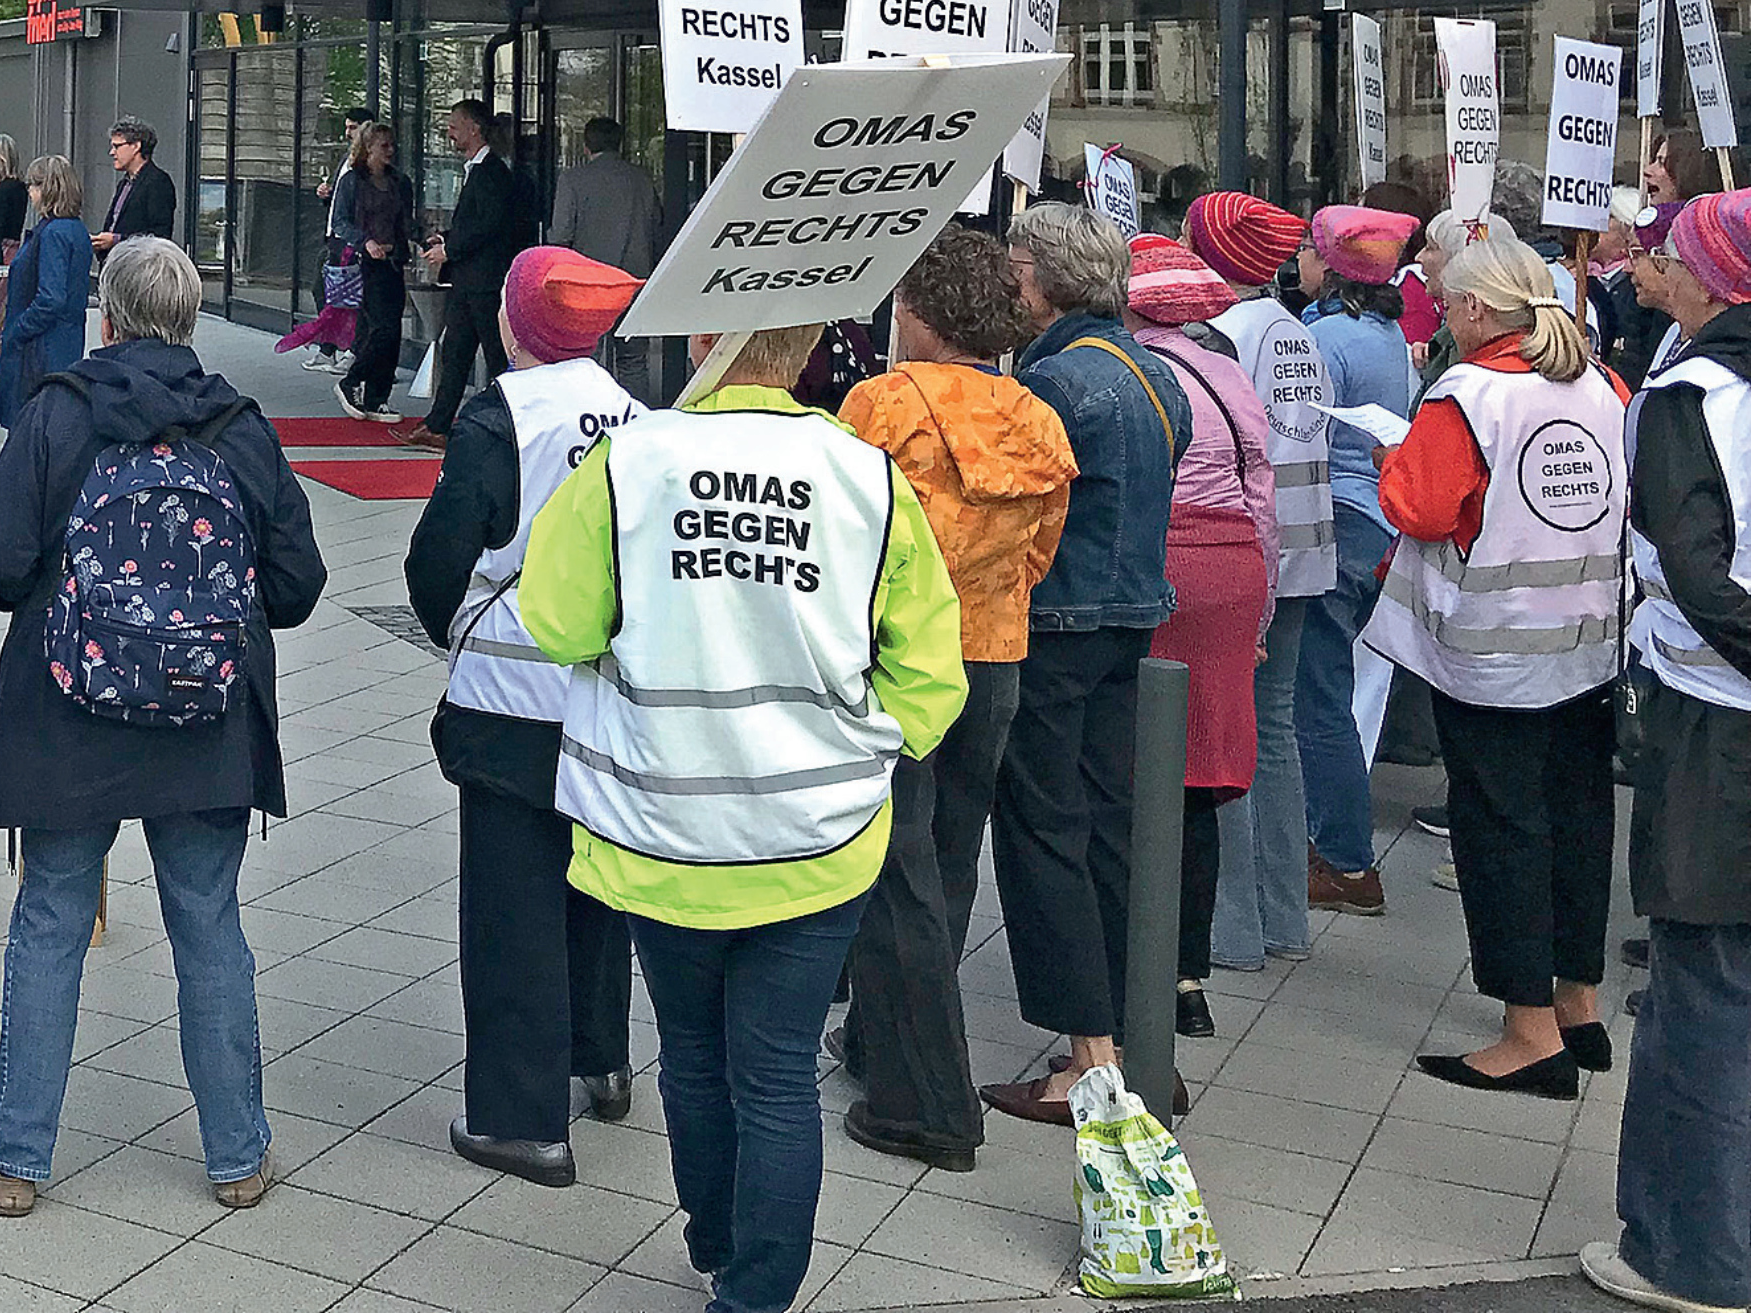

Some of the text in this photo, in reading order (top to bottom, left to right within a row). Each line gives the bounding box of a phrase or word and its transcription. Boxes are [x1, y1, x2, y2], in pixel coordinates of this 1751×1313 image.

[681, 8, 790, 43] RECHTS
[697, 56, 781, 89] Kassel
[1565, 54, 1614, 86] OMAS
[1460, 74, 1492, 99] OMAS
[814, 111, 976, 148] OMAS
[1458, 107, 1497, 131] GEGEN
[1559, 115, 1613, 147] GEGEN
[762, 160, 956, 199] GEGEN
[1105, 174, 1130, 200] OMAS
[1548, 175, 1612, 209] RECHTS
[1106, 194, 1134, 222] GEGEN
[711, 208, 928, 248] RECHTS
[701, 256, 874, 293] Kassel
[1273, 362, 1317, 380] GEGEN
[1272, 385, 1322, 404] RECHTS
[1543, 441, 1585, 456] OMAS
[1541, 461, 1593, 477] GEGEN
[690, 470, 812, 510] OMAS
[1541, 482, 1600, 499] RECHTS
[673, 509, 811, 551] GEGEN
